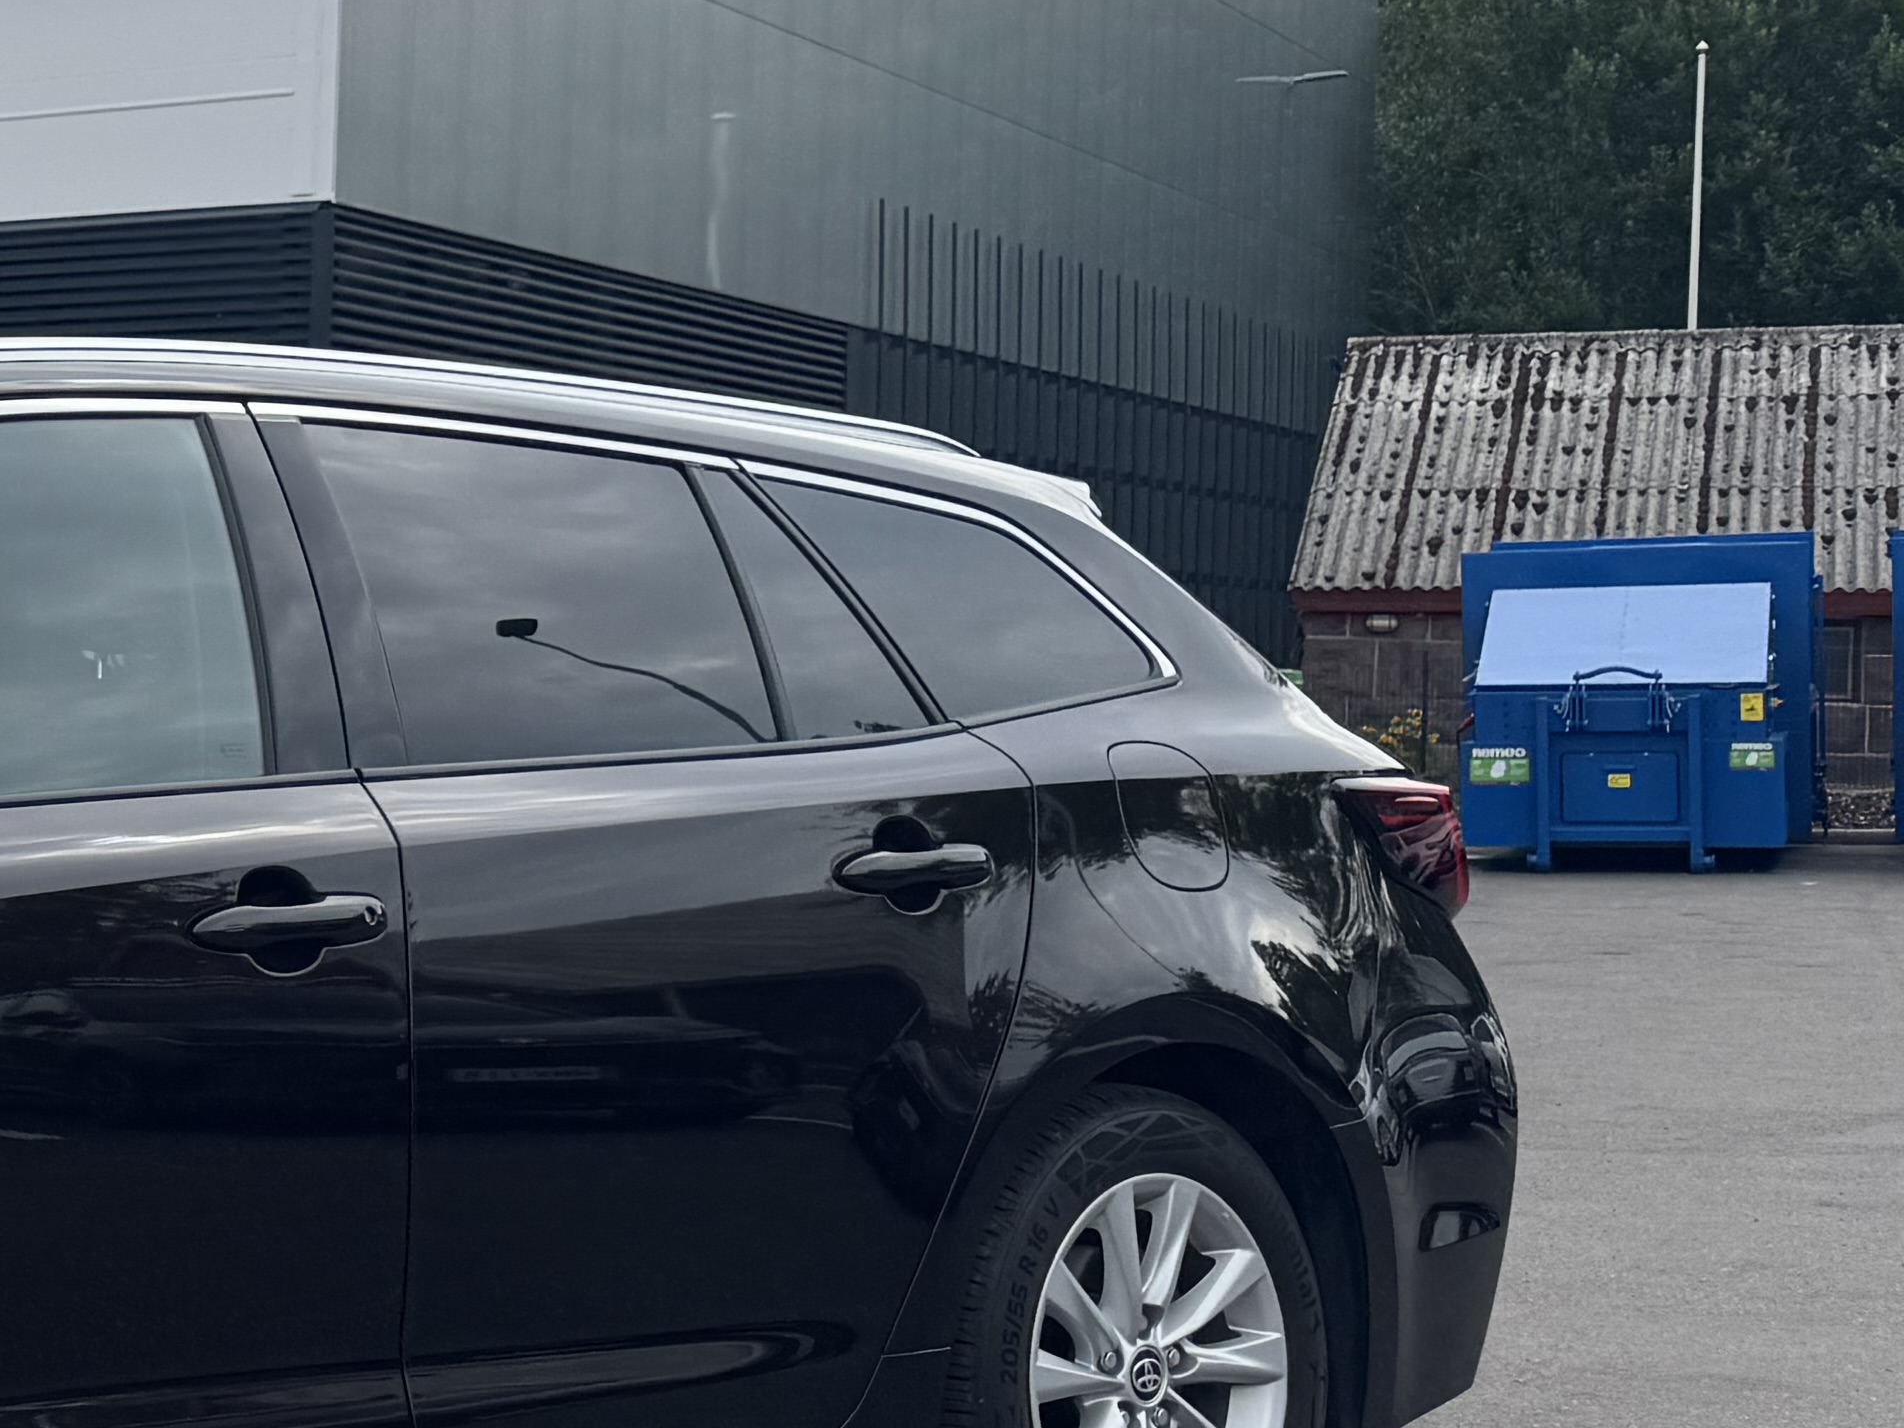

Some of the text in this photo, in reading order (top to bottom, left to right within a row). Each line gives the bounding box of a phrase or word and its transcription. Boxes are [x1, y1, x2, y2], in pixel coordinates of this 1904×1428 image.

[1027, 1222, 1049, 1252] 16
[1018, 1253, 1038, 1277] R
[1000, 1280, 1028, 1385] 205/55
